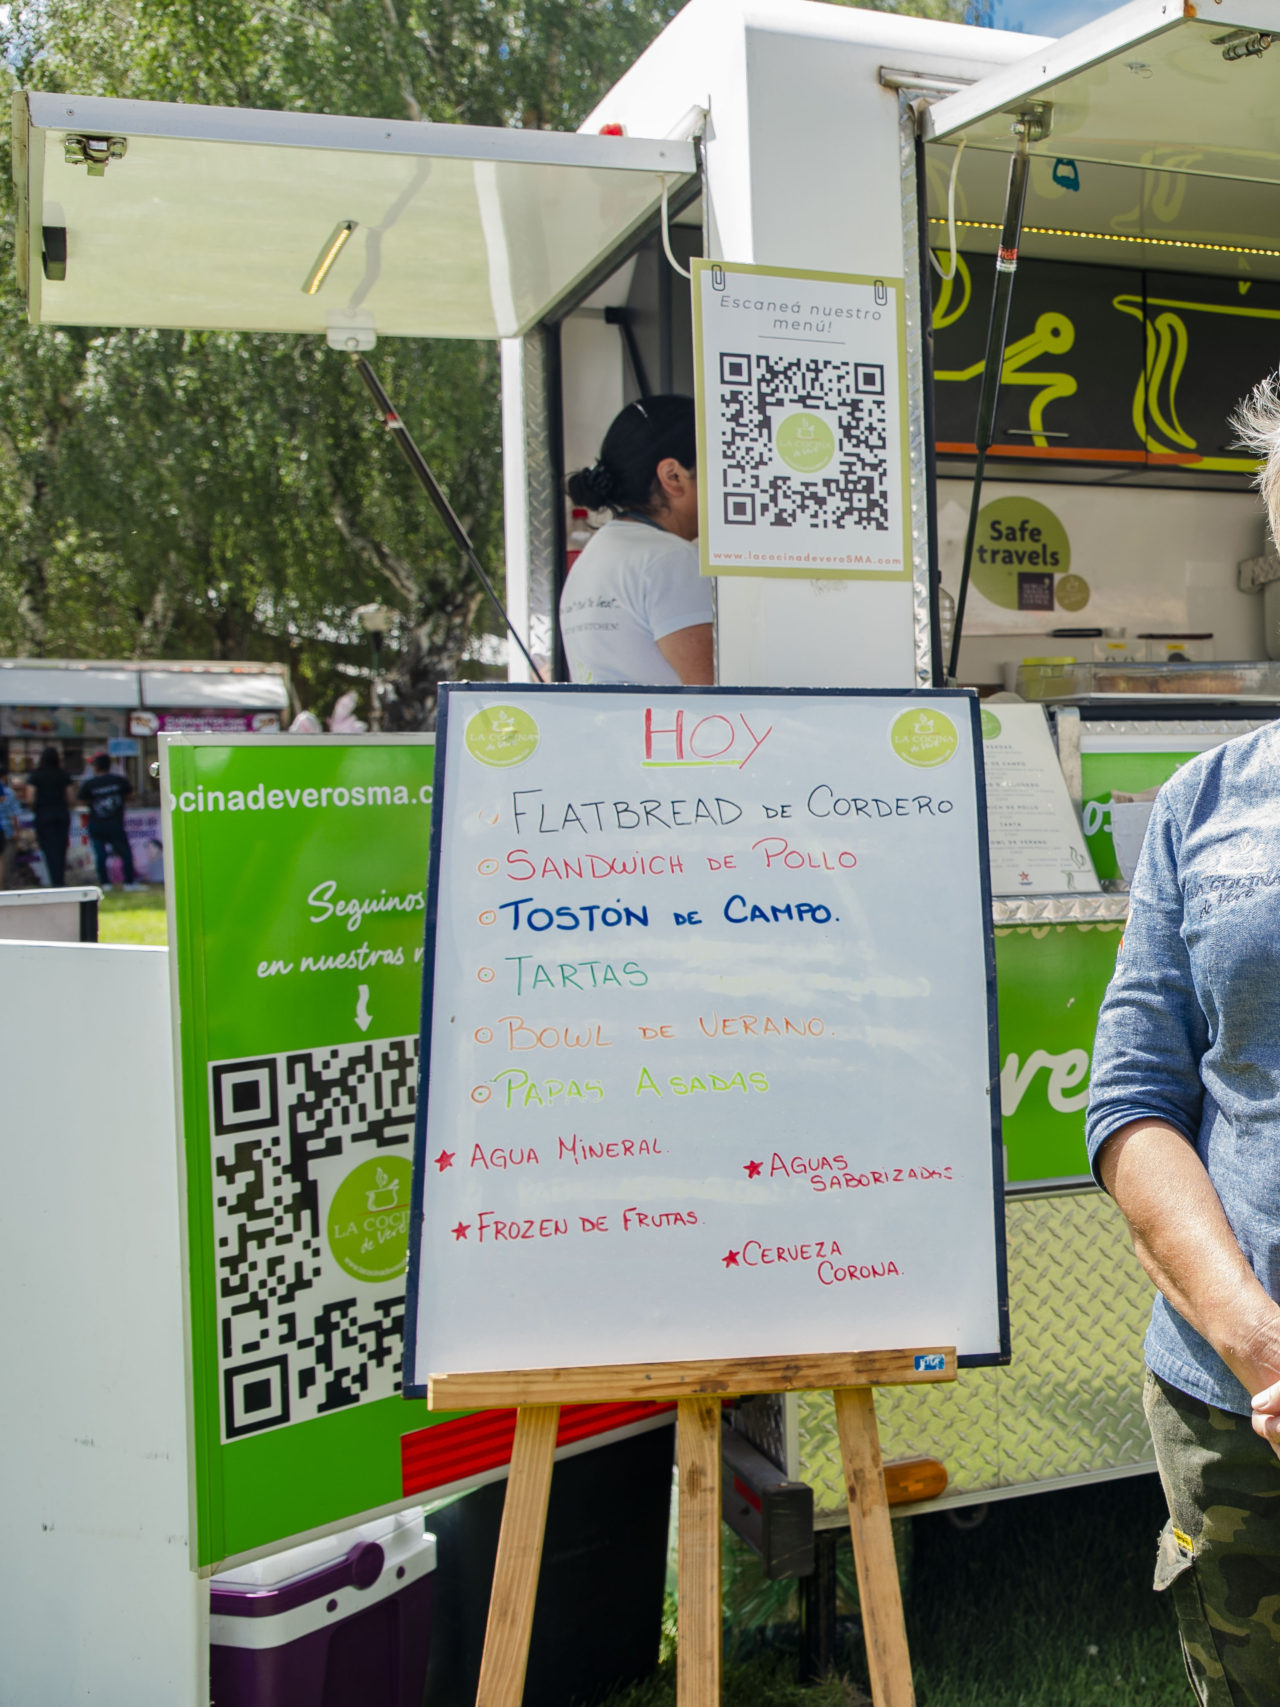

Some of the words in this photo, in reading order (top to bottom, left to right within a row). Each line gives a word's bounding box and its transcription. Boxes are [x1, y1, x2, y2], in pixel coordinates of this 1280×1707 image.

[720, 295, 801, 314] Escaneá
[810, 304, 882, 321] nuestro
[773, 318, 832, 333] menú!
[990, 519, 1042, 543] Safe
[977, 543, 1060, 567] travels
[642, 707, 773, 770] HOY
[512, 788, 743, 834] FLATBREAD
[807, 784, 953, 820] CORDERO
[752, 837, 858, 871] POLLO
[308, 880, 424, 930] Seguinos
[257, 958, 293, 978] en
[300, 942, 404, 972] nuestras
[505, 955, 649, 995] TARTAS
[498, 1016, 612, 1051] BOWL
[492, 1068, 603, 1108] PAPAS
[471, 1143, 539, 1170] AGUA
[769, 1153, 848, 1178] AGUAS
[334, 1221, 358, 1239] LA
[477, 1211, 568, 1242] FROZEN
[742, 1240, 842, 1266] CERVEZA
